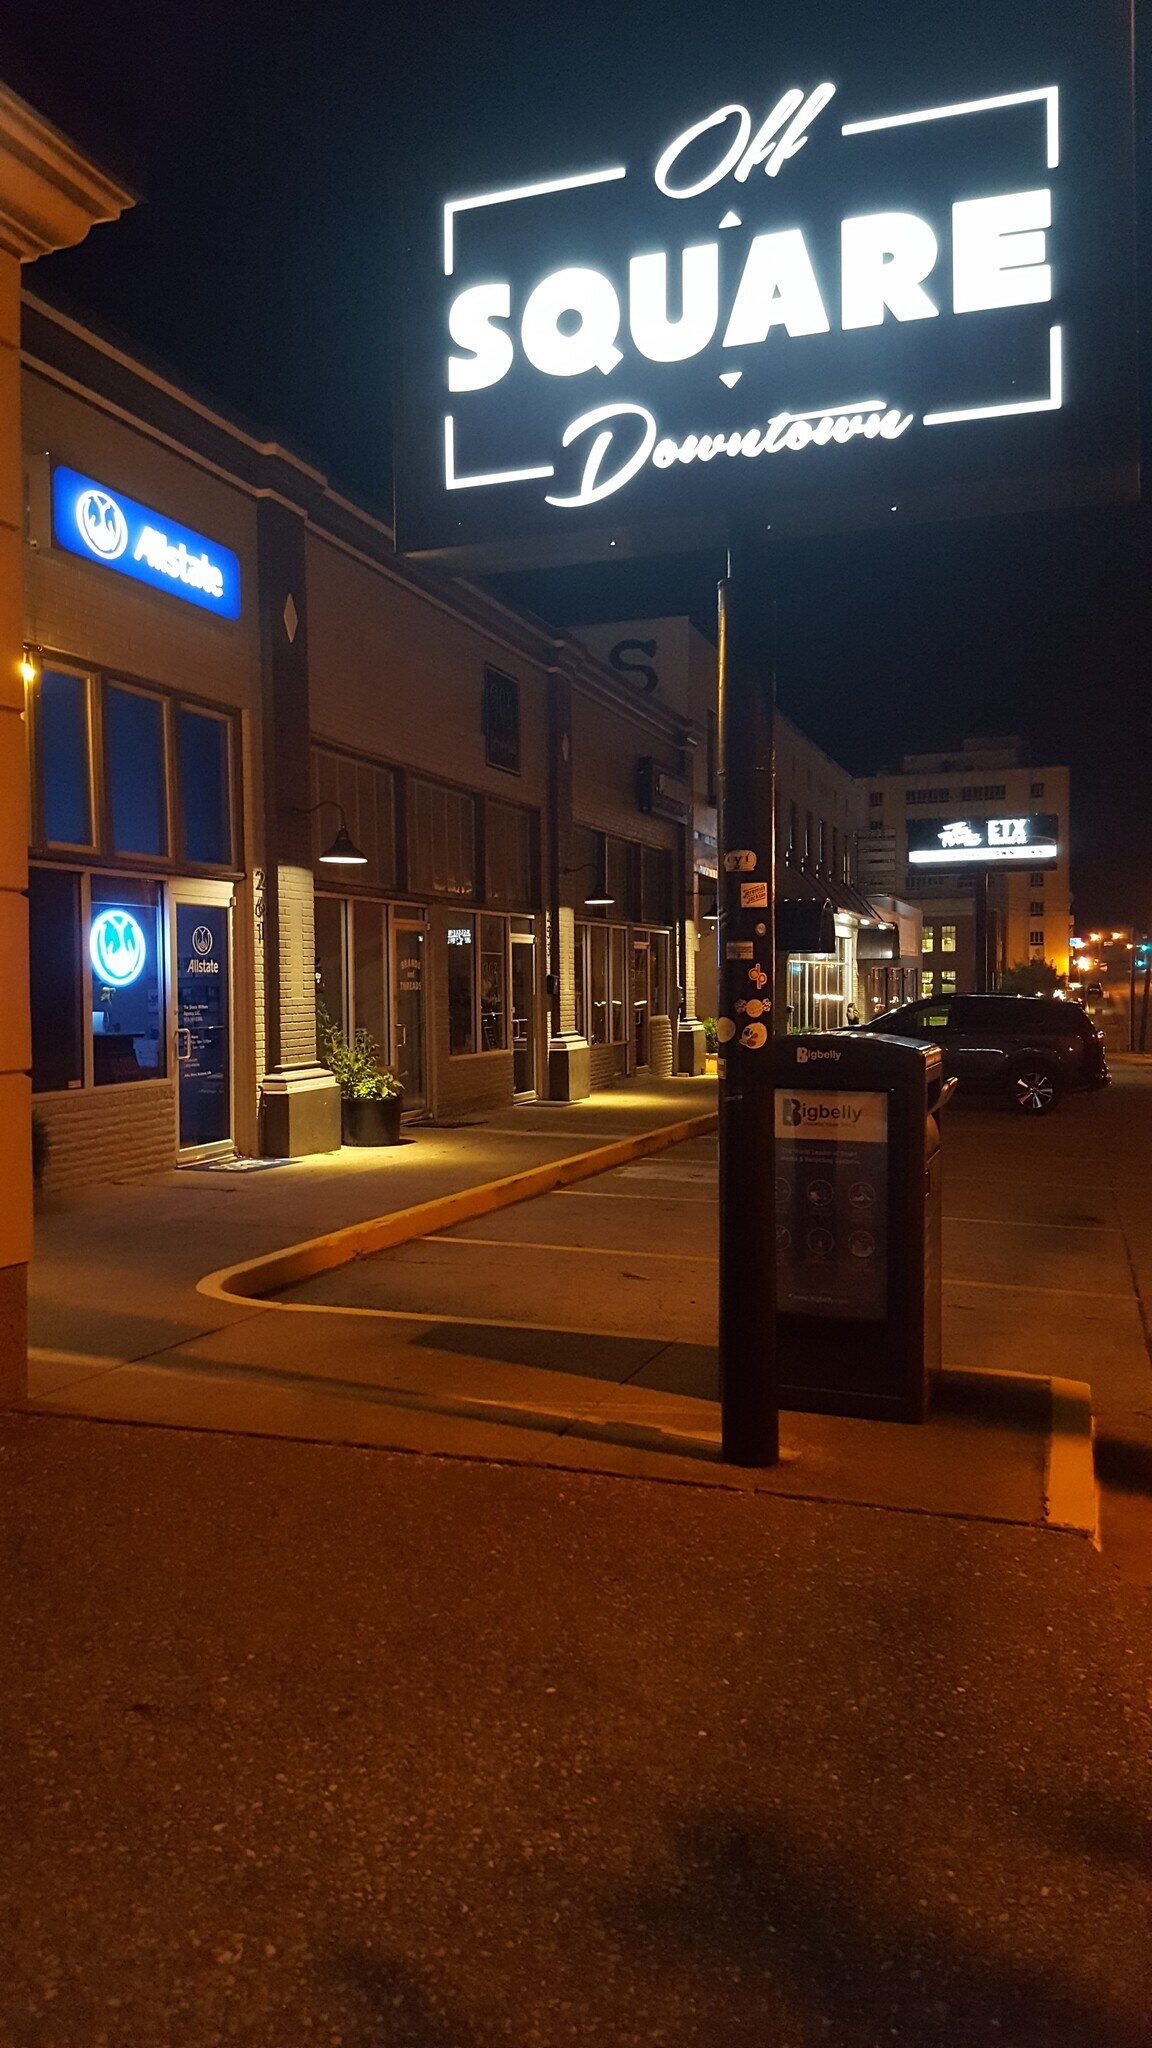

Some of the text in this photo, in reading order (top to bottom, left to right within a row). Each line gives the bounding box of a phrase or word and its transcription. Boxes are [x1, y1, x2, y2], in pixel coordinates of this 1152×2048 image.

[654, 82, 836, 199] Off
[447, 187, 1053, 393] SQUARE
[544, 399, 915, 508] Downtown
[134, 526, 224, 599] Allstate
[609, 639, 658, 695] S
[187, 959, 219, 974] Allstate
[797, 1047, 842, 1064] Bigbelly
[782, 1099, 862, 1126] Bigbelly
